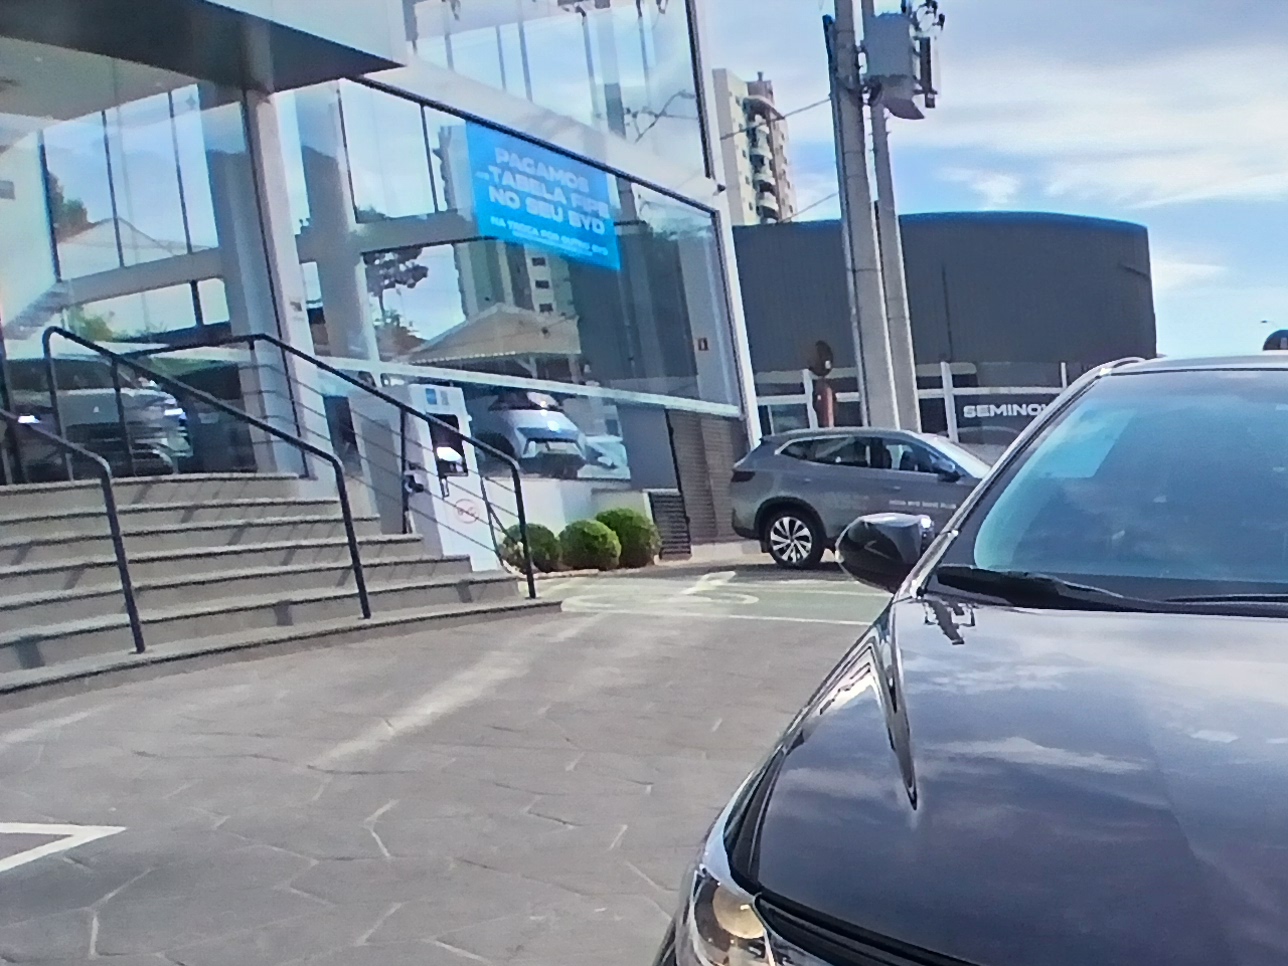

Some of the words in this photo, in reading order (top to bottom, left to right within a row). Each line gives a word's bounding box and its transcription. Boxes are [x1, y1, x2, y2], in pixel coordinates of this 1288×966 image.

[488, 165, 567, 205] TABELA
[494, 147, 589, 193] PAGAMOS
[488, 186, 520, 210] NO
[525, 197, 564, 223] SEU
[568, 210, 606, 235] BYD
